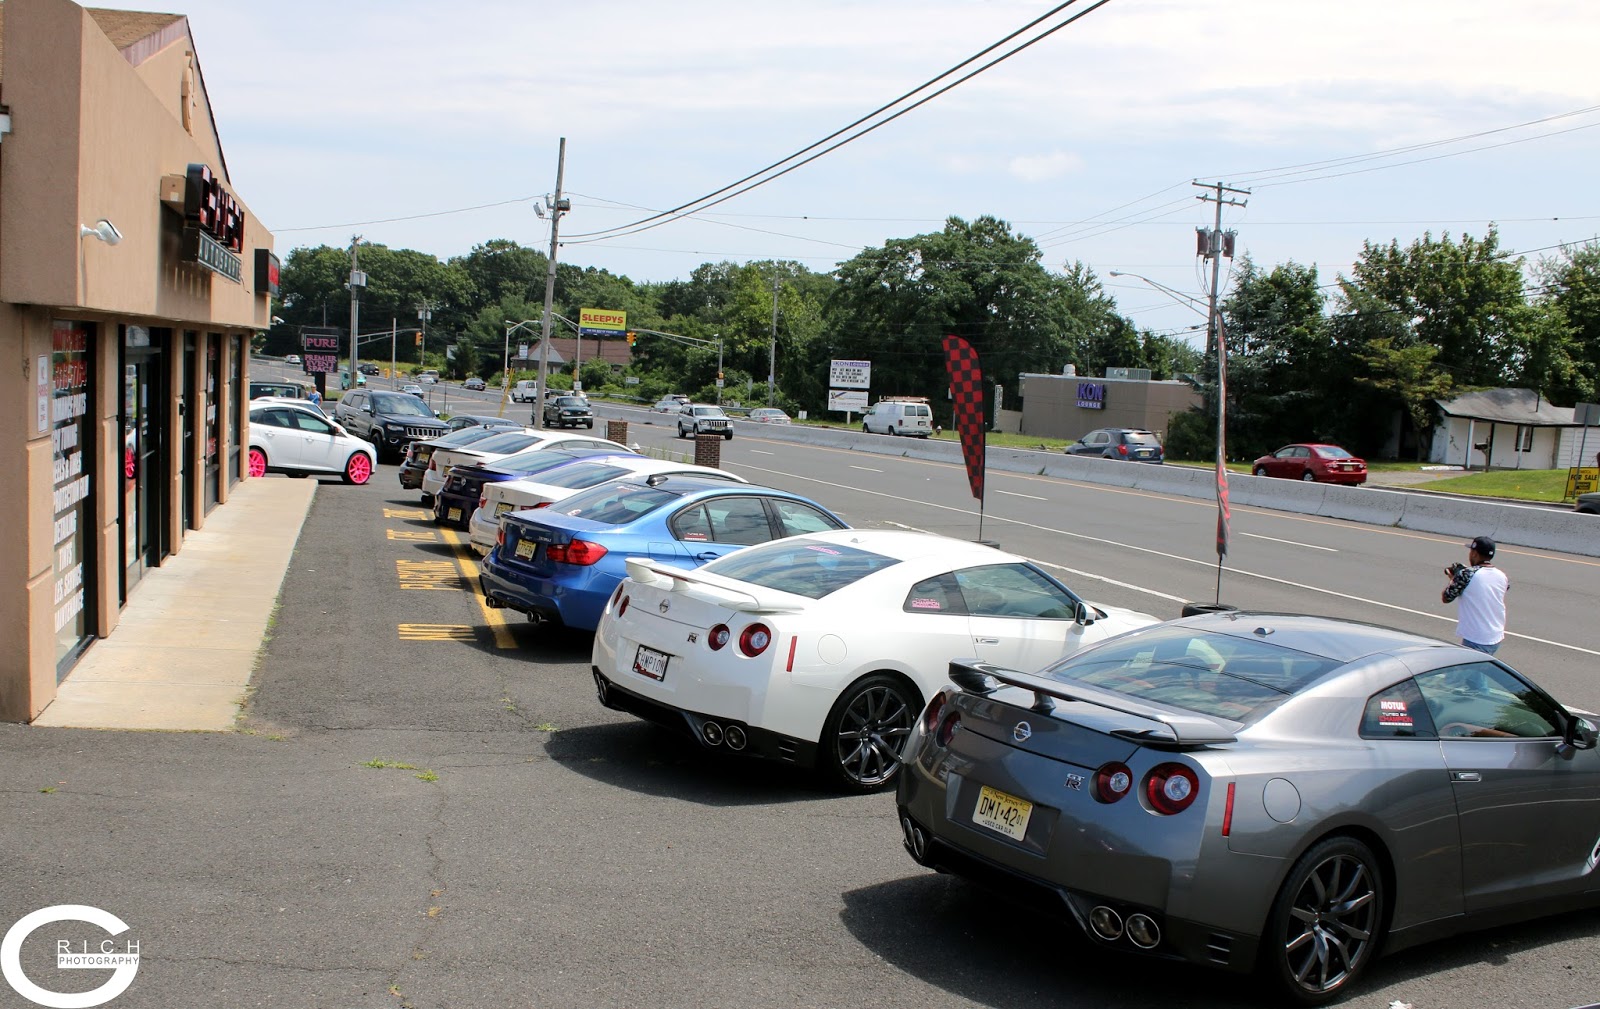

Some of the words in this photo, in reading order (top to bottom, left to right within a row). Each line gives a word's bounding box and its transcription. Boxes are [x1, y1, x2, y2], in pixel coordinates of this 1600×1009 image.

[582, 313, 624, 324] SLEEPYS
[306, 337, 337, 348] PURE
[304, 354, 337, 362] PREMIER
[1076, 383, 1104, 401] IKON
[1077, 400, 1101, 409] LOUNGE
[1380, 701, 1407, 711] MOTUL
